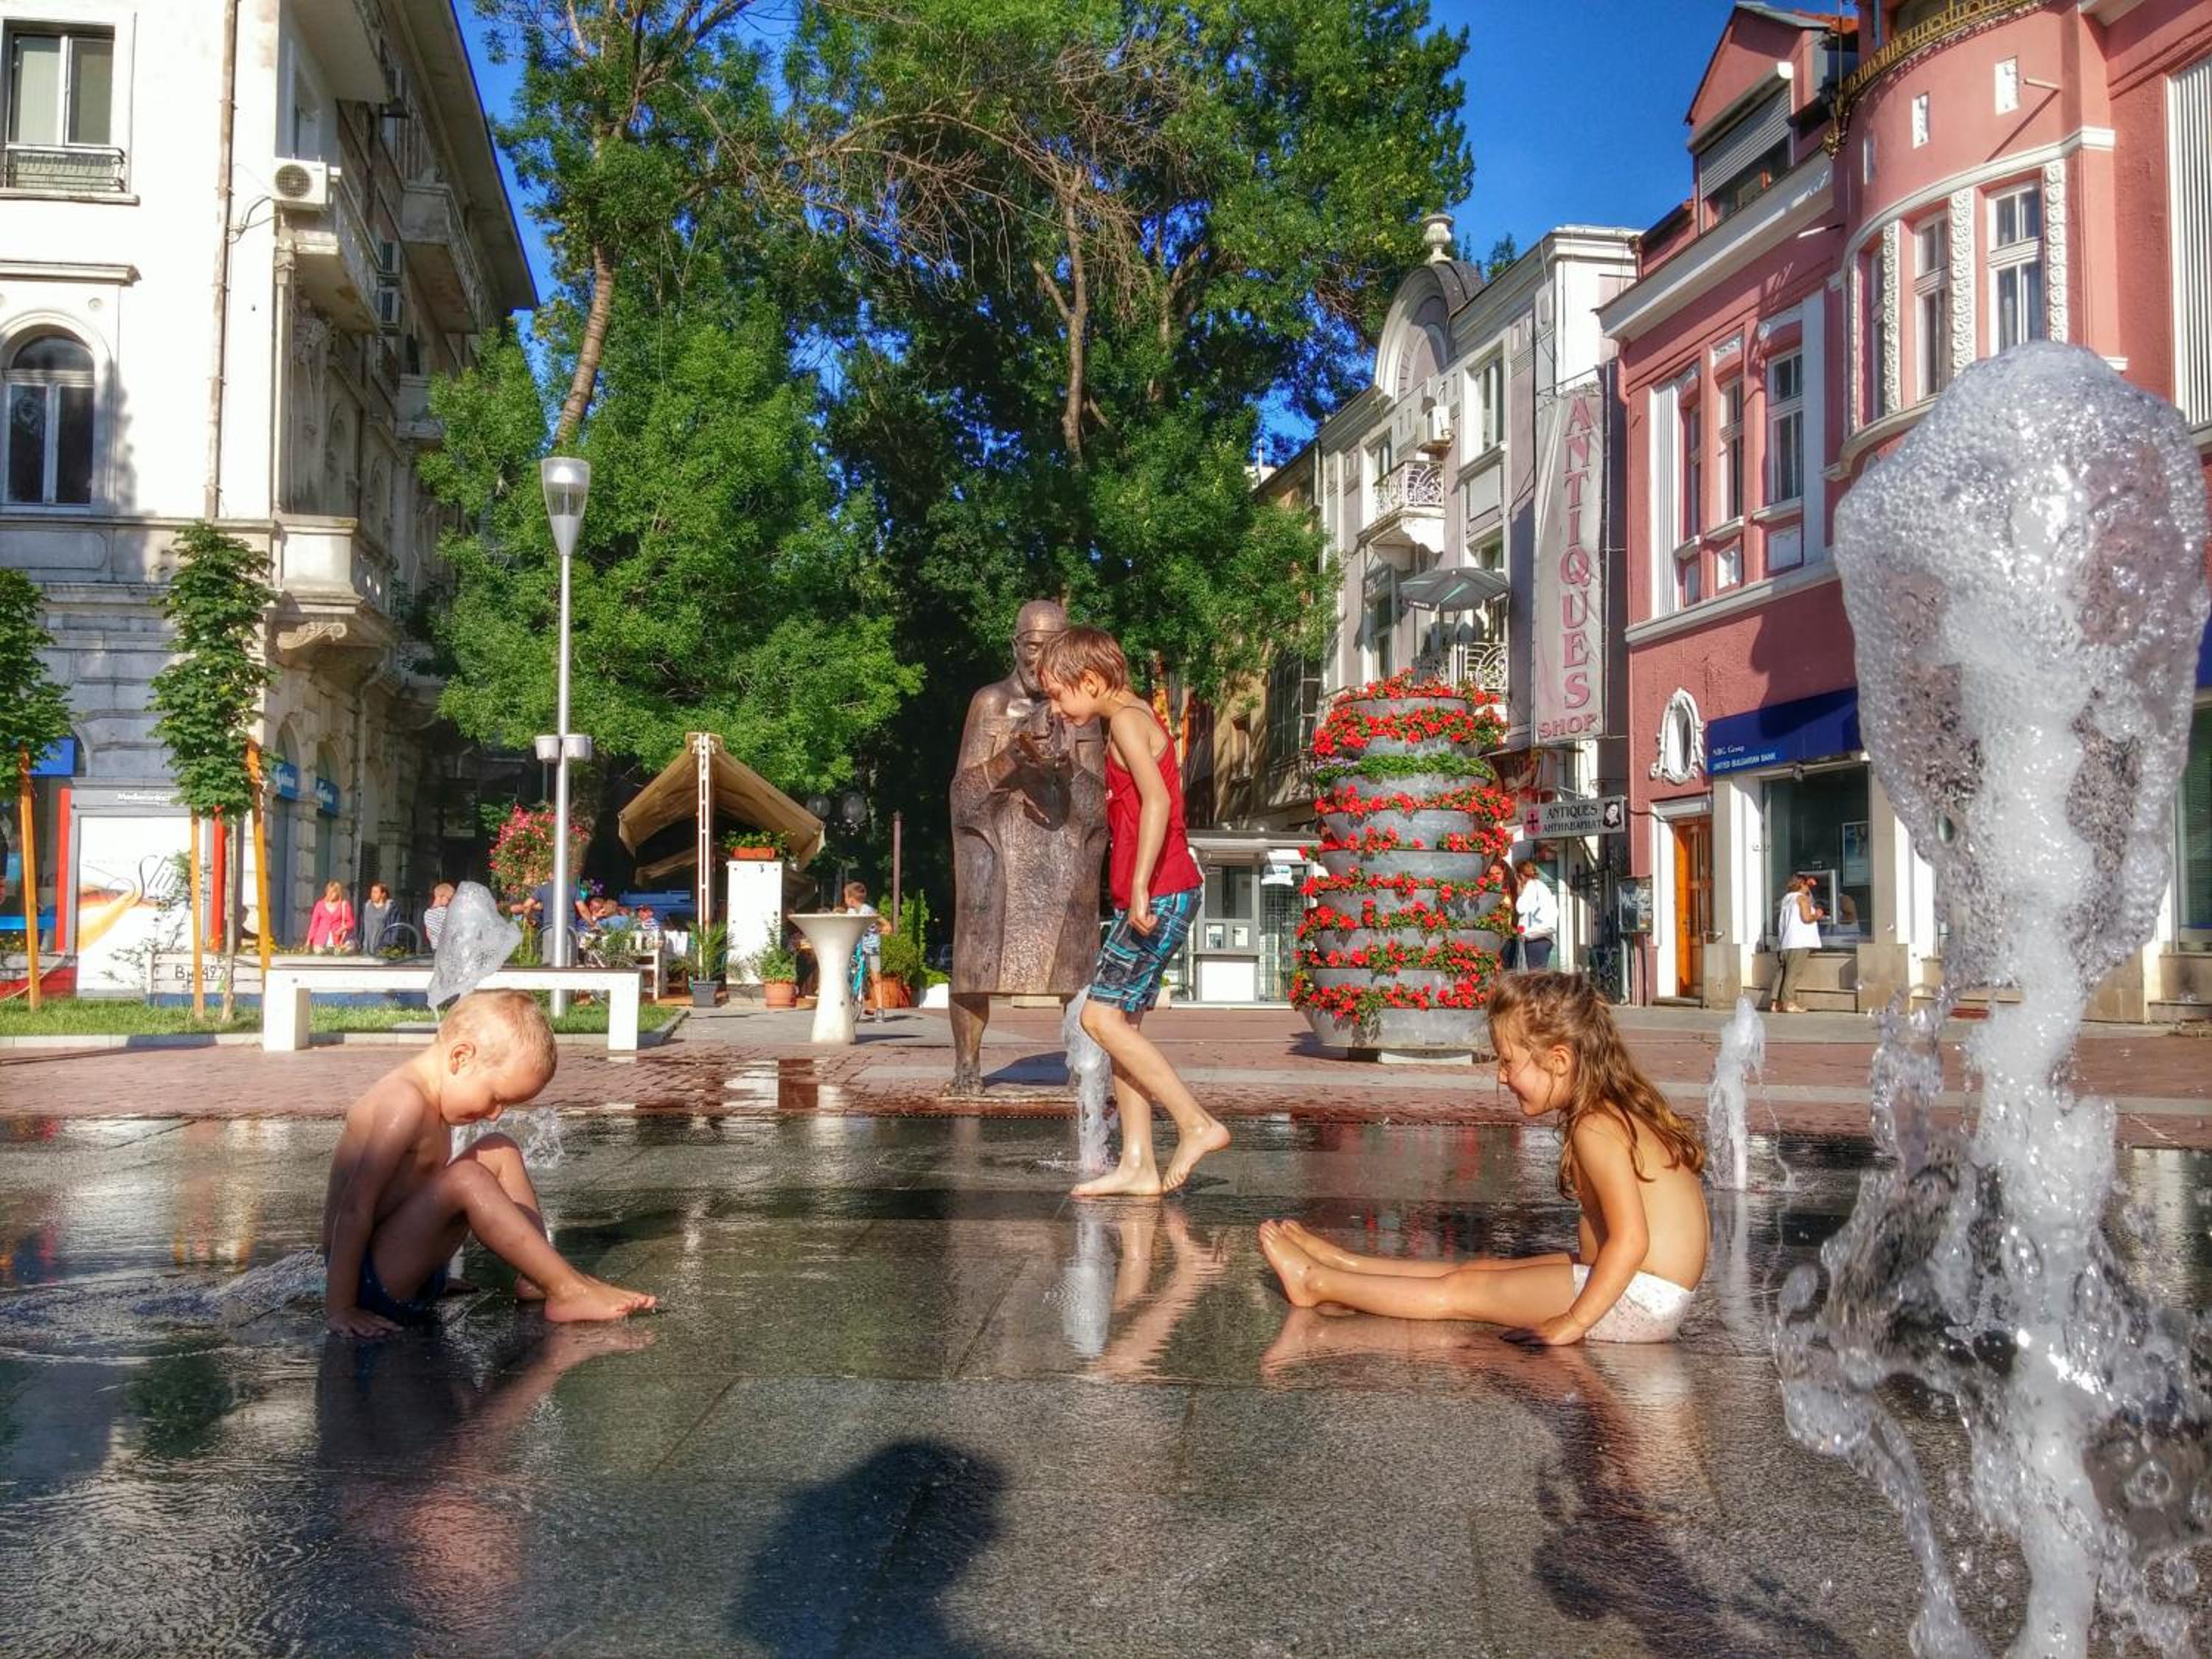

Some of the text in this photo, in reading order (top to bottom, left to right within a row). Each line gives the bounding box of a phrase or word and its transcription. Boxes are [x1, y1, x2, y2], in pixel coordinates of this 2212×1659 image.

[1559, 394, 1592, 709] ANTIQUES
[1539, 714, 1598, 738] SHOP
[1713, 751, 1776, 771] UNITED BULGARIAN BANK
[1546, 803, 1598, 819] ANTIQUES
